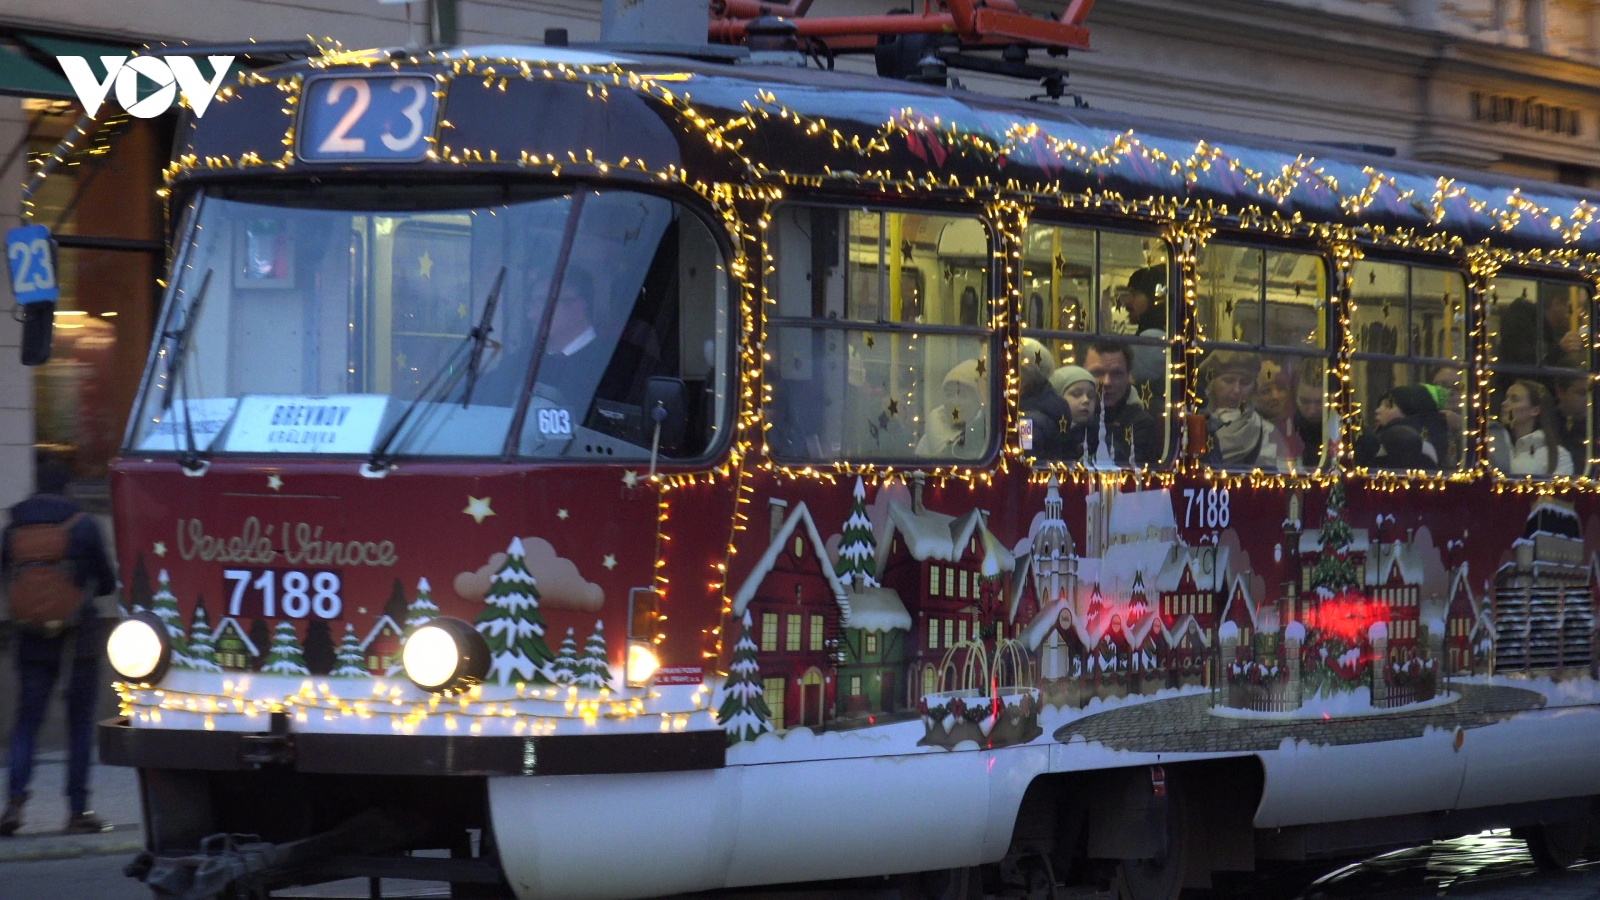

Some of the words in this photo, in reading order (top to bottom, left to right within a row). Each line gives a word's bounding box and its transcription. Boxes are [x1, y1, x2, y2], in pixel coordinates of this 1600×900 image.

[319, 78, 427, 153] 23
[8, 239, 55, 293] 23
[538, 408, 571, 435] 603
[1183, 488, 1230, 528] 7188
[177, 517, 281, 563] Veselé
[282, 522, 398, 566] Vánoce
[223, 569, 343, 619] 7188
